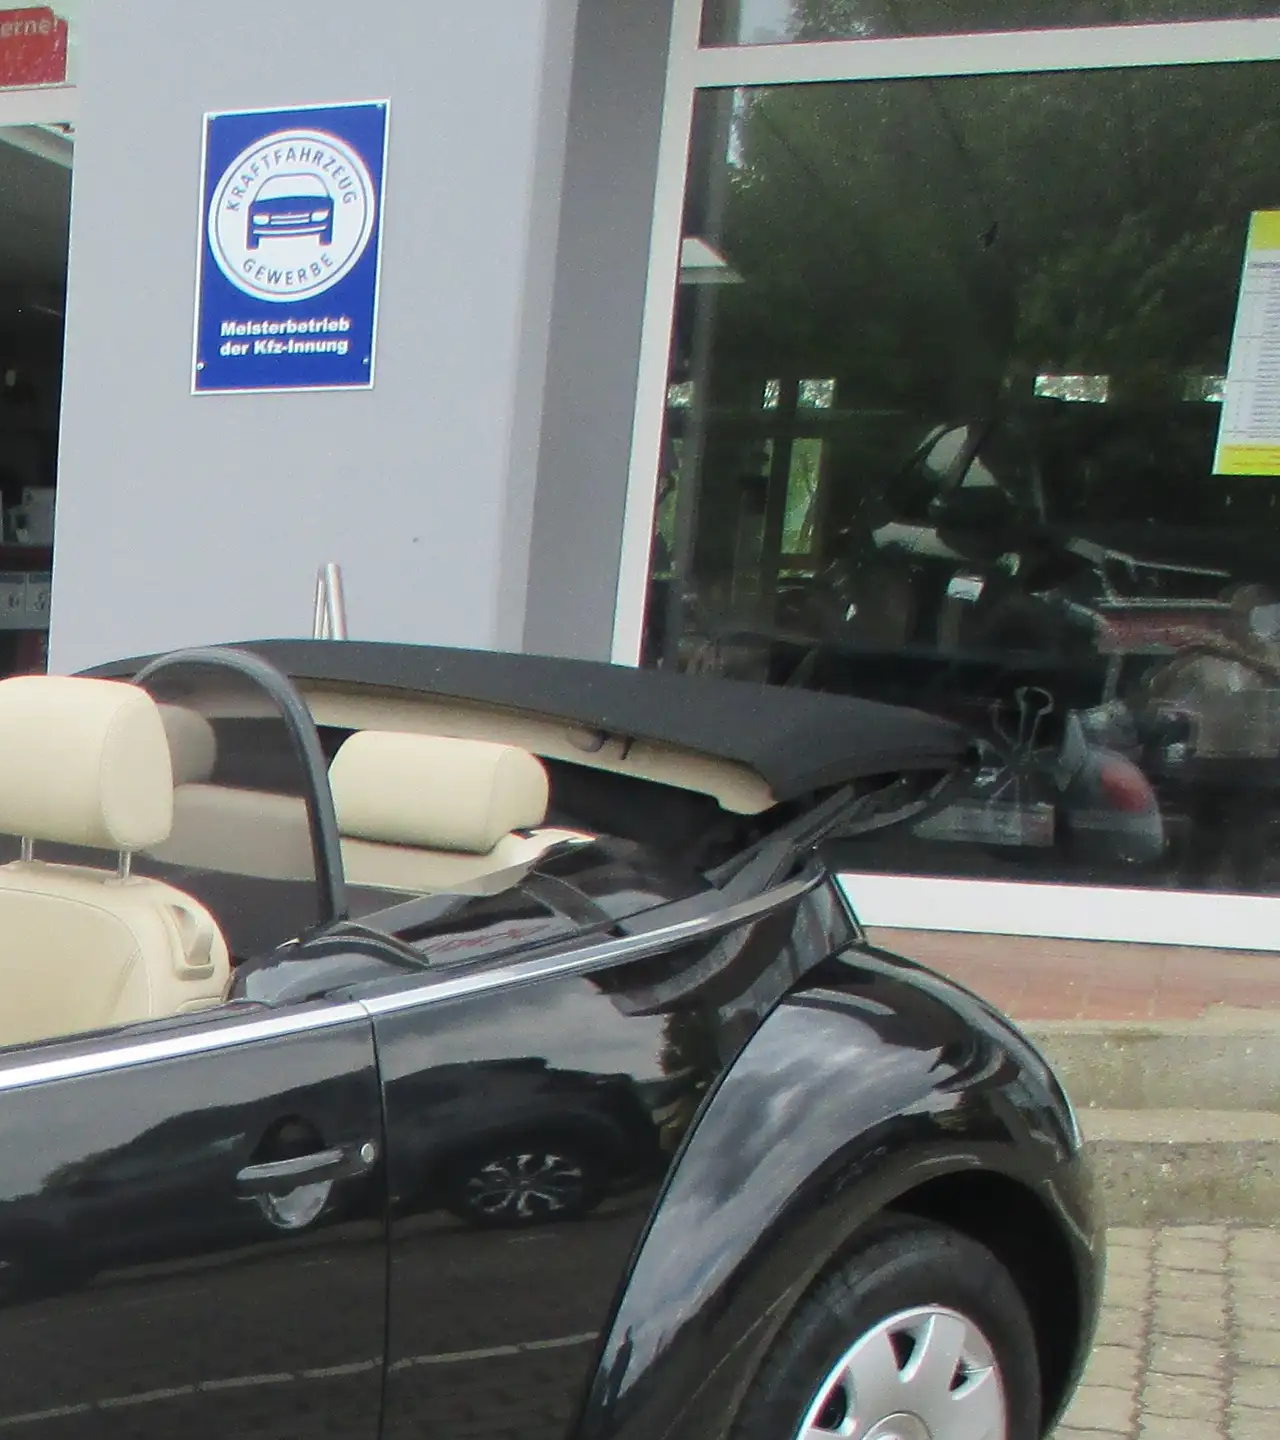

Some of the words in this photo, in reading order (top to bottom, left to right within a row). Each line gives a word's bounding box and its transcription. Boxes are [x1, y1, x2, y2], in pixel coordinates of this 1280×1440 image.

[226, 146, 358, 212] KRAFTFAHRZEUG
[243, 253, 334, 286] GEWERBE
[220, 316, 350, 337] Meisterbetrieb
[220, 341, 249, 357] der
[253, 337, 349, 356] Kfz-Innung
